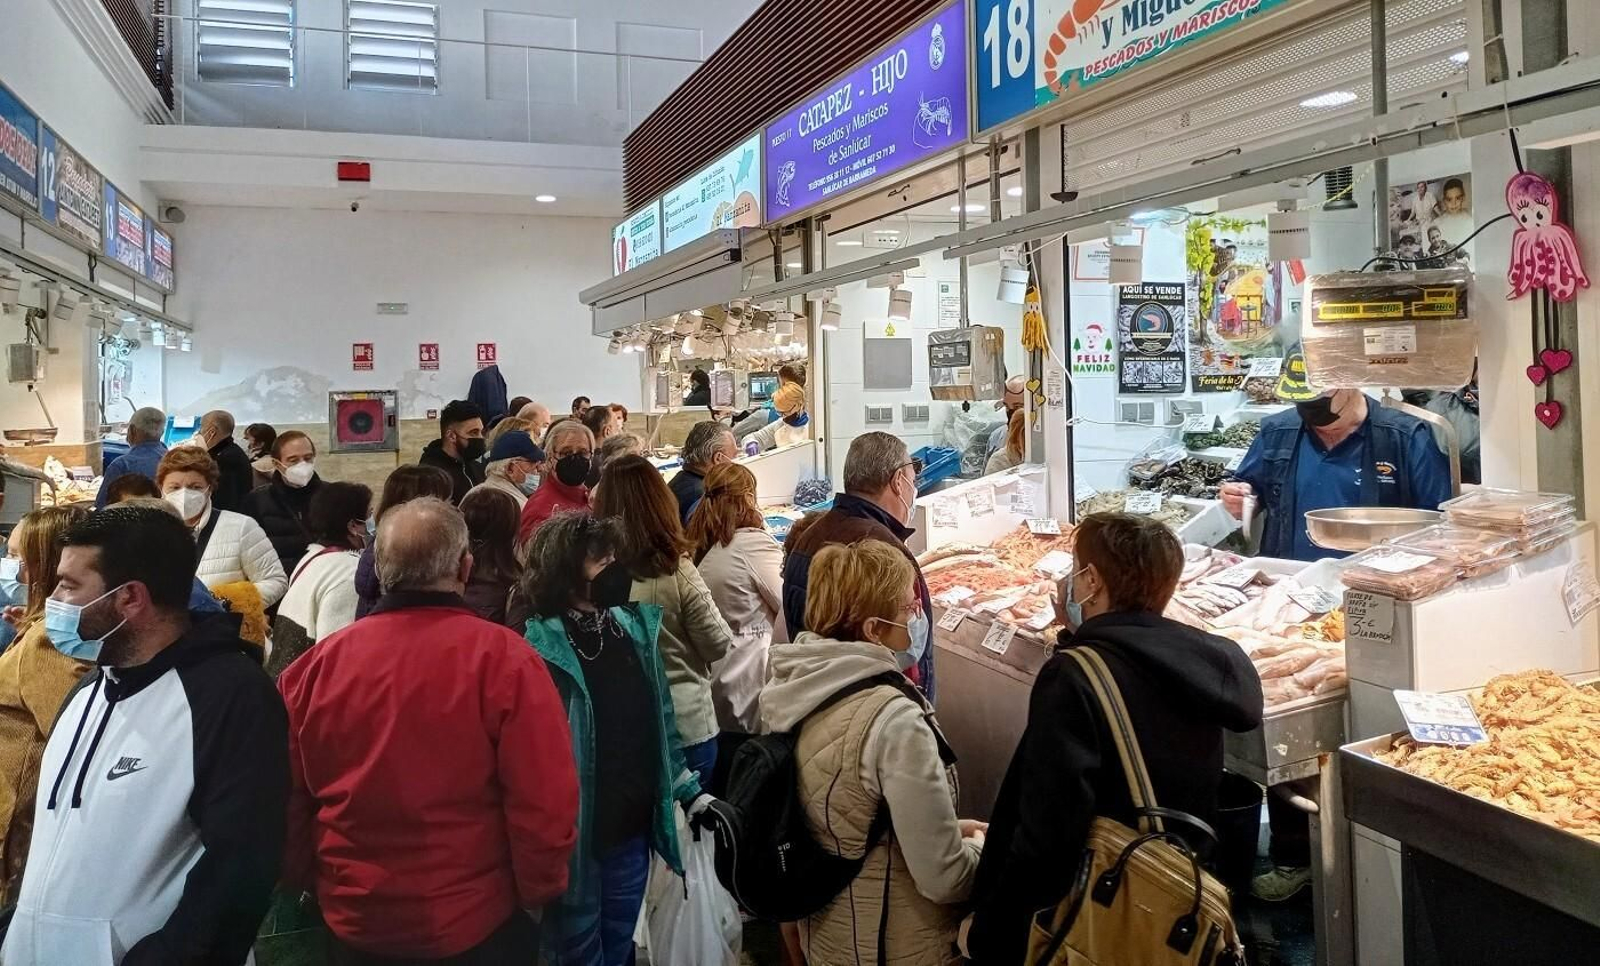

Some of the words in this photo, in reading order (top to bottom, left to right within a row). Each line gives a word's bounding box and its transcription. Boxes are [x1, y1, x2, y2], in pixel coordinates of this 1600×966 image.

[983, 0, 1031, 89] 18
[1101, 15, 1114, 49] y
[1083, 36, 1155, 80] PESCADOS
[1158, 29, 1168, 46] Y
[798, 82, 852, 137] CATAPEZ
[871, 48, 908, 96] HIJO
[812, 127, 844, 153] Pescados
[845, 123, 851, 139] y
[852, 102, 889, 133] Mariscos
[828, 150, 838, 165] de
[839, 134, 872, 161] Sanlúcar
[42, 147, 55, 201] 12
[1144, 286, 1154, 294] SE
[1155, 286, 1182, 295] VENDE
[1073, 363, 1115, 373] NAVIDAD
[1077, 354, 1110, 363] FELIZ
[1198, 375, 1218, 387] Feria
[1218, 375, 1227, 385] de
[1227, 375, 1234, 385] la
[115, 756, 142, 771] NIKE
